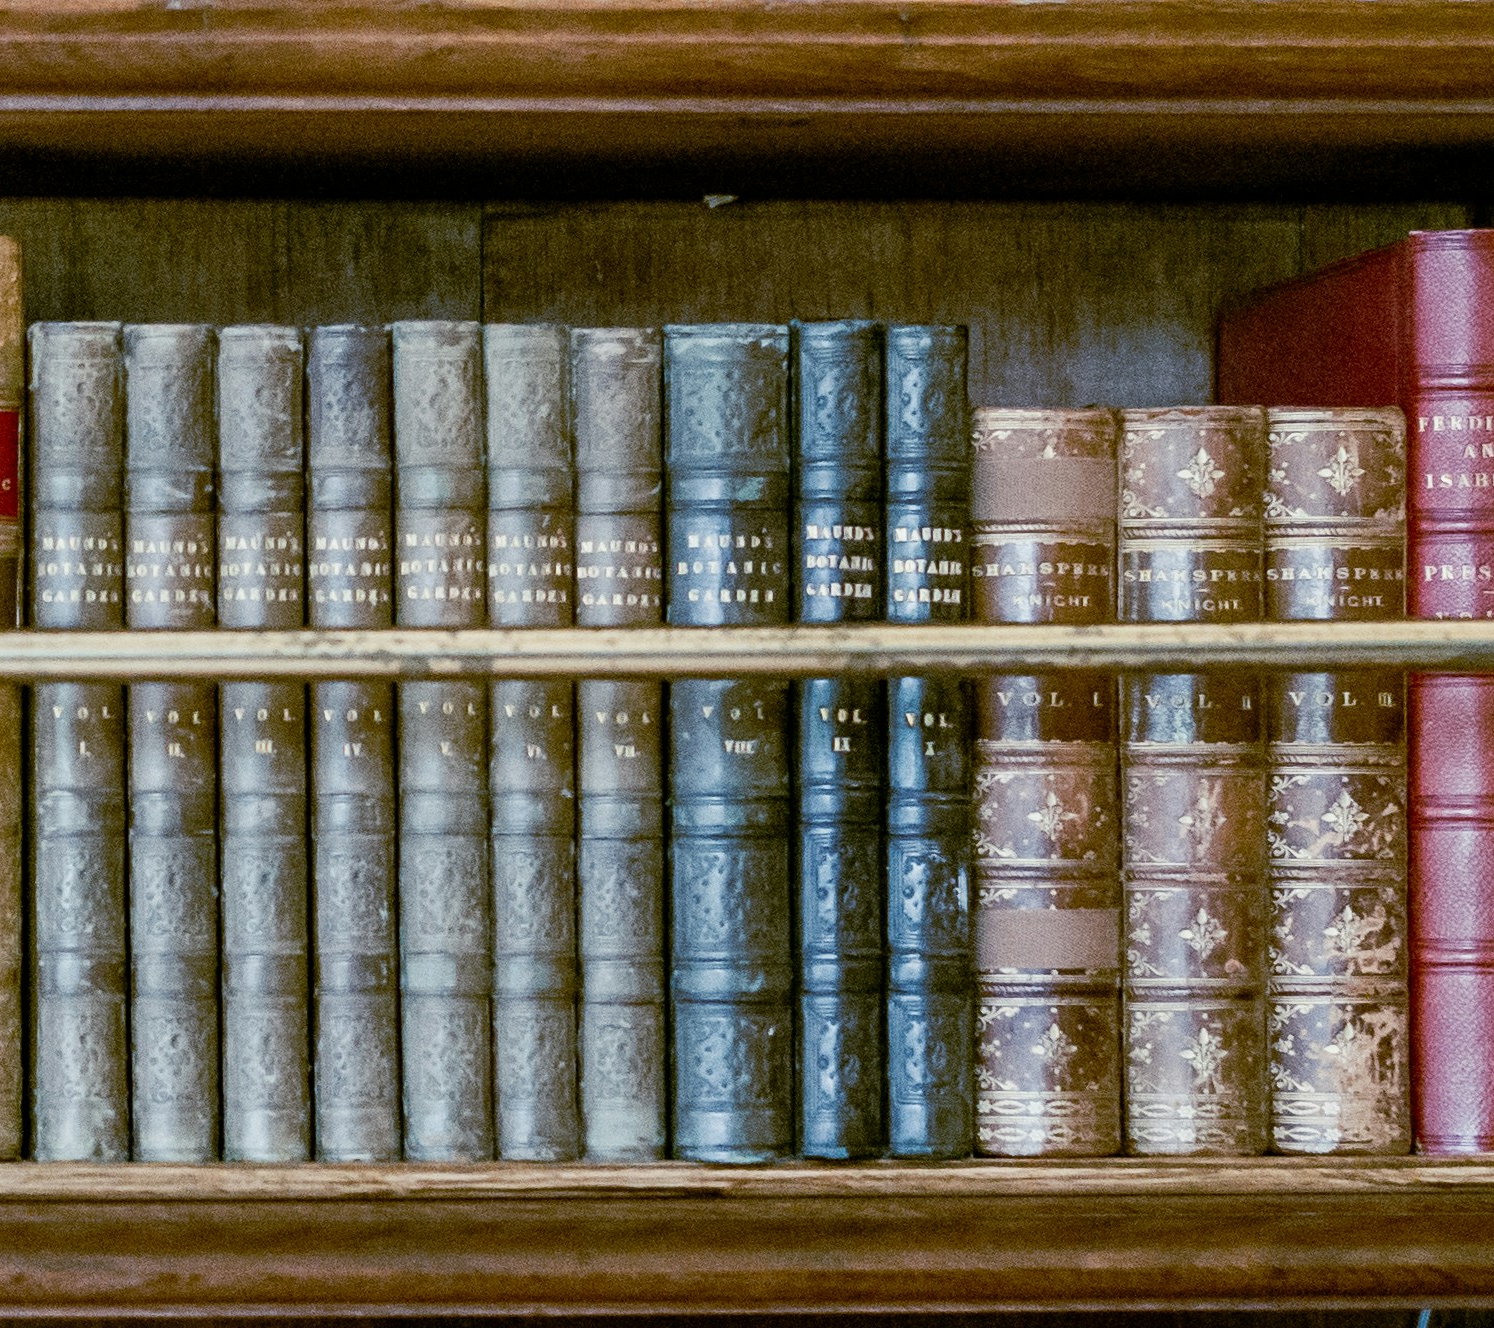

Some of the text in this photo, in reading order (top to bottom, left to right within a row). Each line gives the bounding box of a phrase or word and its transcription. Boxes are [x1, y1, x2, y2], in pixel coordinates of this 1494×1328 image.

[37, 563, 121, 577] BOTANIC
[678, 561, 781, 575] BOTANIC
[42, 588, 119, 603] GARDEN
[688, 589, 774, 603] GARDEN
[806, 583, 872, 599] GARDEN
[894, 589, 961, 604] GARDEN
[1013, 595, 1089, 607] KNIGHT
[1162, 598, 1240, 611] KNIGHT
[1306, 594, 1383, 607] KNIGHT
